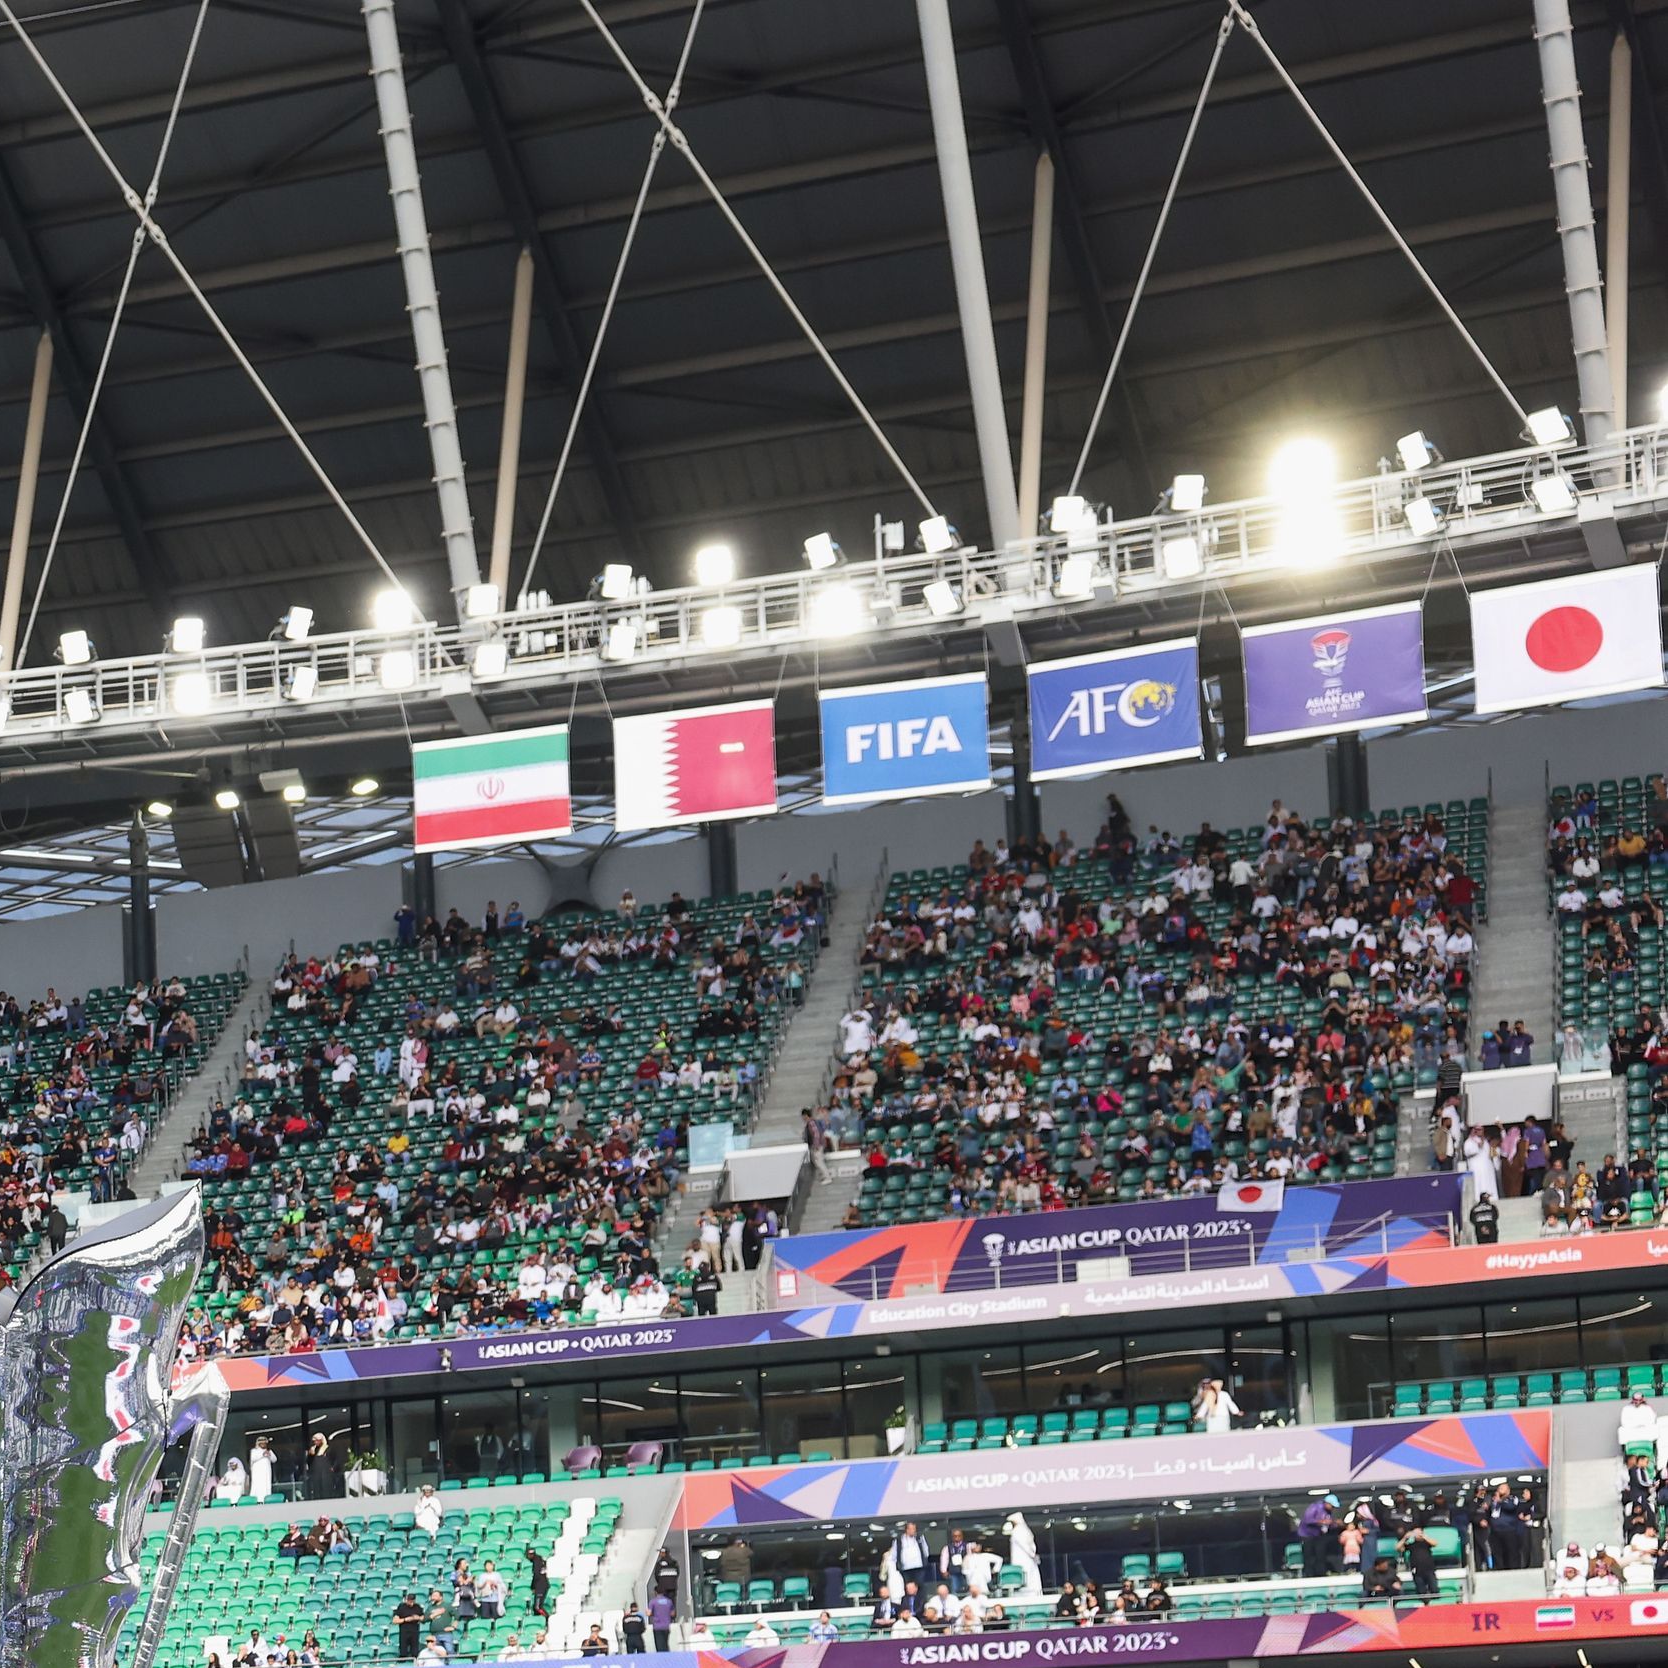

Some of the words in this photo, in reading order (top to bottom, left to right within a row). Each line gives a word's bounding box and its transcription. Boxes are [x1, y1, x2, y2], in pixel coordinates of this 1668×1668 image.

[1048, 679, 1168, 742] AFC
[845, 715, 963, 764] FIFA
[1015, 1236, 1076, 1255] ASIAN
[1077, 1229, 1121, 1248] CUP
[1125, 1224, 1189, 1247] QATAR
[1192, 1221, 1241, 1239] 2023
[1485, 1247, 1582, 1270] #HayyaAsia
[869, 1304, 947, 1324] Education
[948, 1301, 979, 1321] City
[981, 1296, 1048, 1315] Stadium
[484, 1341, 534, 1358] ASIAN
[536, 1338, 566, 1354] CUP
[580, 1331, 632, 1351] QATAR
[912, 1474, 970, 1493] ASIAN
[971, 1471, 1008, 1490] CUP
[1021, 1465, 1079, 1489] QATAR
[1083, 1462, 1126, 1481] 2023
[909, 1644, 980, 1665] ASIAN
[981, 1640, 1031, 1661] CUP
[1036, 1636, 1108, 1661] QATAR
